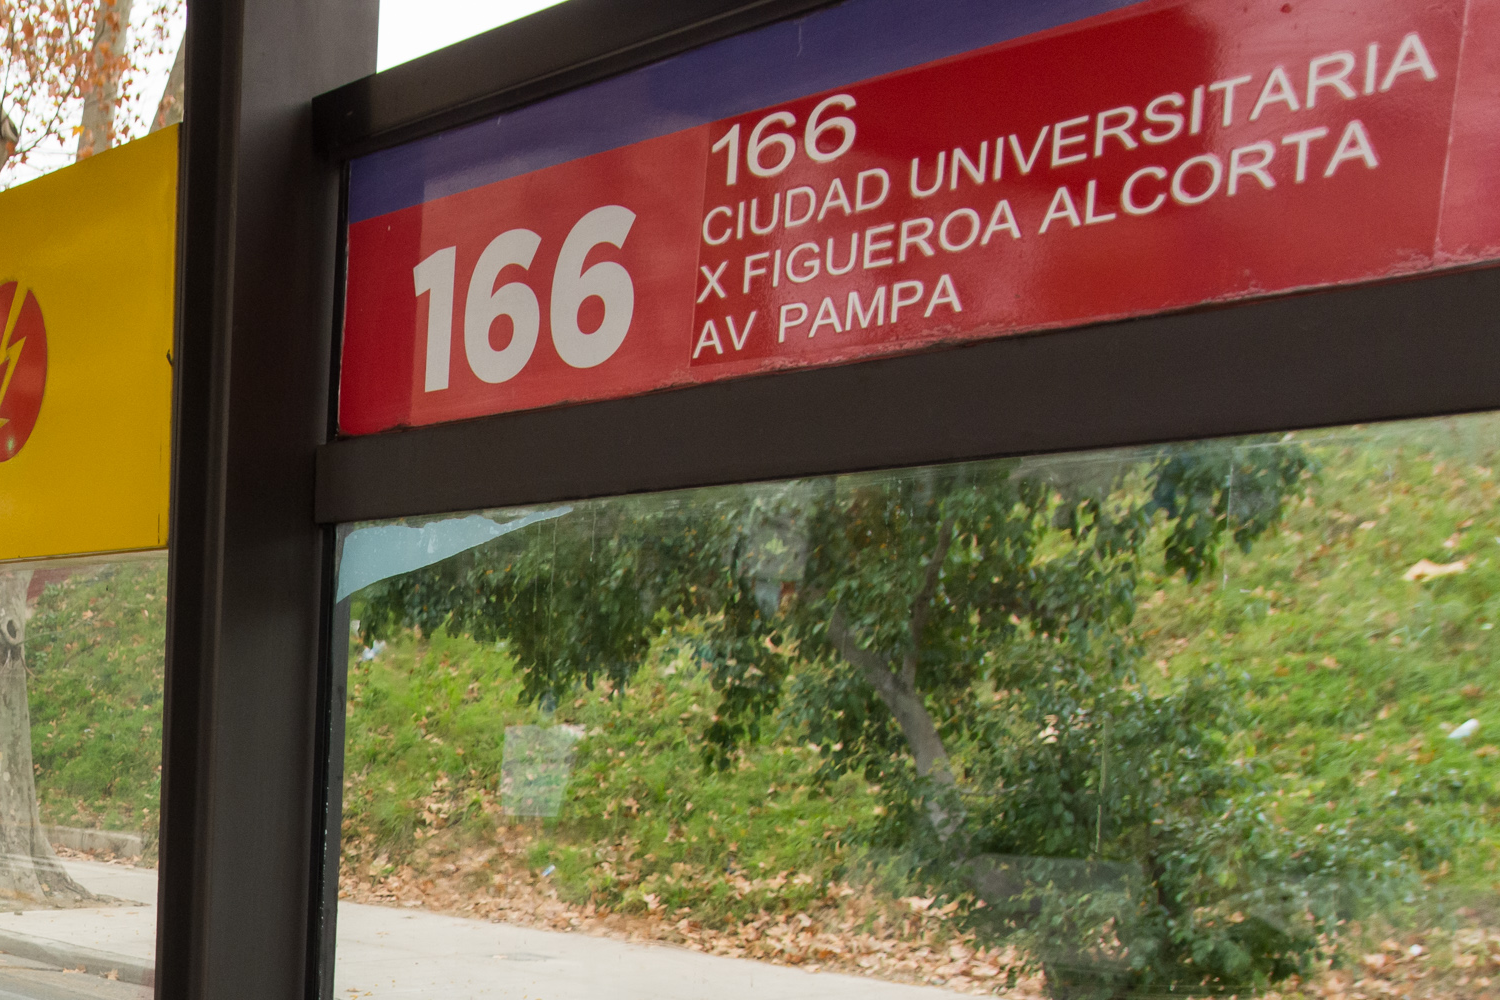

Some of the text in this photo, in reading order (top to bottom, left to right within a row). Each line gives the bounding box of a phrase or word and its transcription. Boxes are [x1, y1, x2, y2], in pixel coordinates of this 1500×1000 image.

[696, 119, 1380, 303] X FIGUEROA ALCORTA
[702, 31, 1437, 246] CIUDAD UNIVERSITARIA
[711, 94, 857, 186] 166
[412, 204, 637, 393] 166
[692, 274, 963, 359] AV PAMPA
